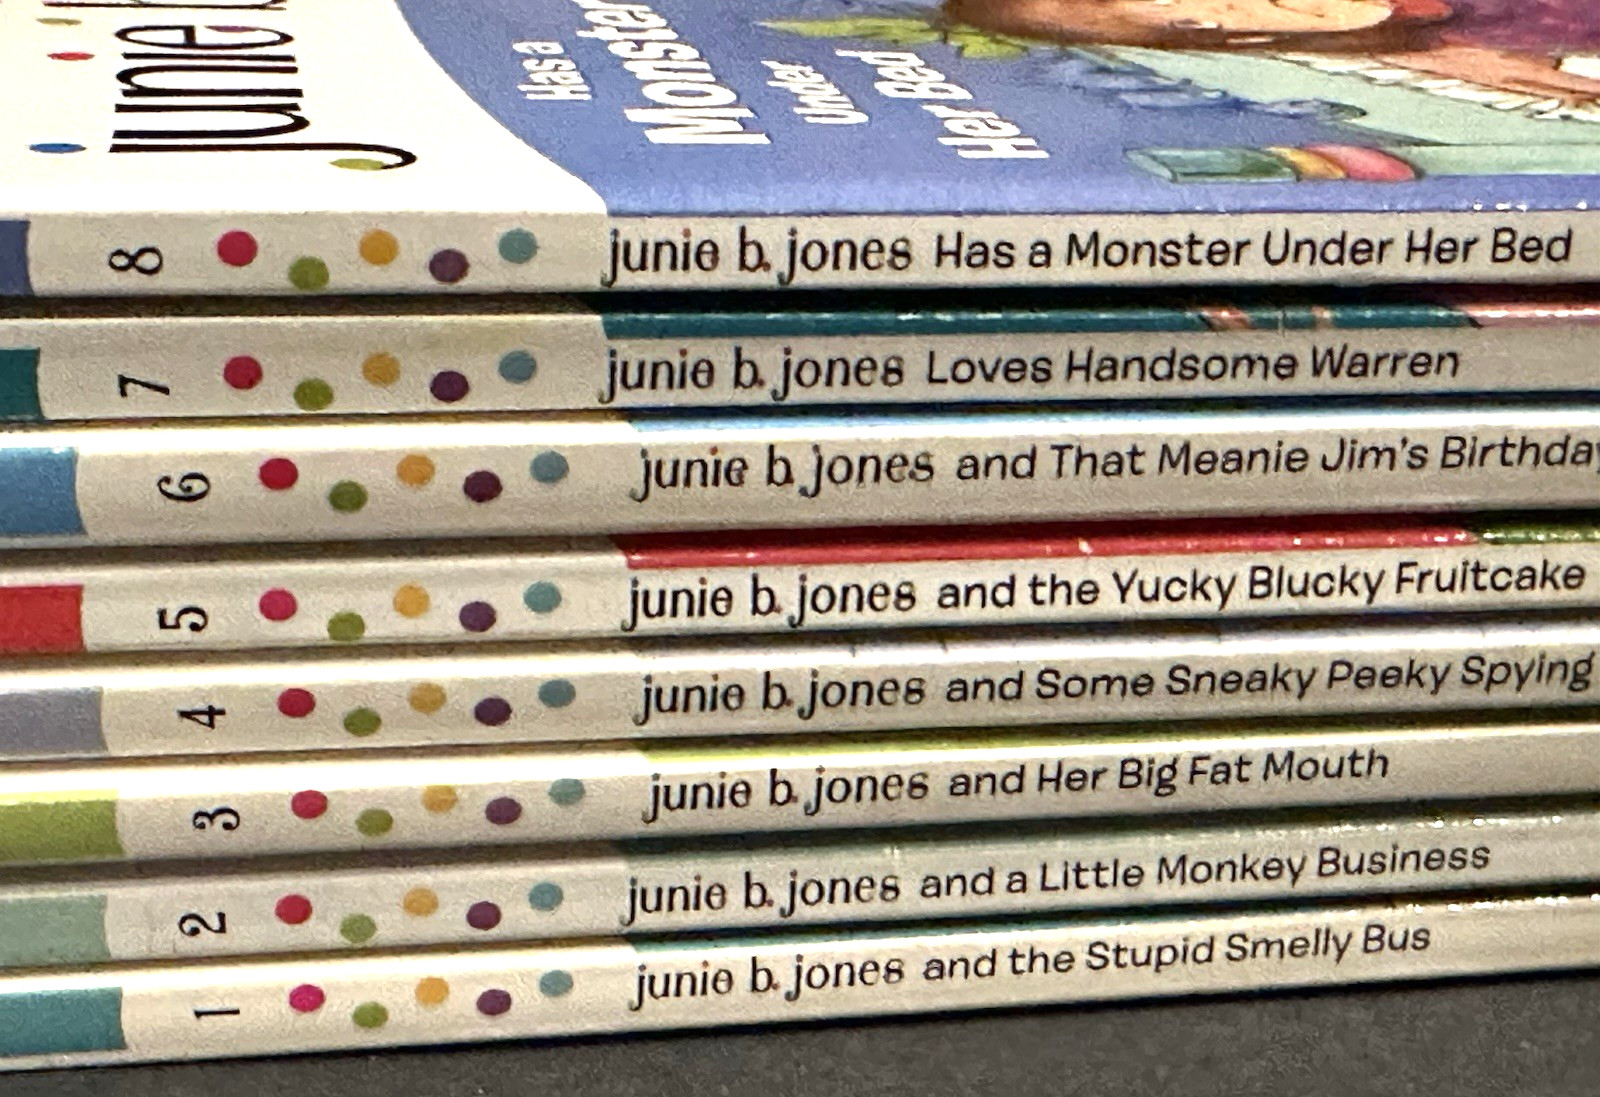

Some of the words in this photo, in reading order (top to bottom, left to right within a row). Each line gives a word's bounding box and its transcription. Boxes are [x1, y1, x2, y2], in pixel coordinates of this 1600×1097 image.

[511, 40, 565, 55] a
[573, 0, 772, 145] Monster
[834, 48, 974, 101] Bed
[28, 25, 417, 170] junie
[517, 57, 593, 101] Has
[760, 59, 870, 125] Under
[920, 103, 1050, 159] Her
[107, 246, 164, 276] 8
[600, 228, 720, 288] junie
[738, 225, 772, 273] b.
[777, 227, 914, 287] jones
[935, 230, 1015, 270] Has
[1028, 240, 1052, 269] a
[1066, 230, 1252, 268] Monster
[1263, 228, 1394, 267] Under
[1405, 227, 1480, 265] Her
[1491, 226, 1573, 264] Bed
[117, 373, 171, 399] 7
[597, 348, 715, 404] junie
[733, 345, 766, 390] b.
[770, 346, 904, 402] jones
[926, 350, 1053, 386] Loves
[1065, 346, 1299, 384] Handsome
[1311, 342, 1460, 380] Warren
[156, 471, 211, 503] 6
[629, 448, 749, 503] junie
[766, 443, 796, 488] b.
[799, 444, 935, 499] jones
[956, 444, 1038, 481] and
[1050, 443, 1147, 479] That
[1158, 439, 1310, 477] Meanie
[1320, 436, 1429, 473] Jim's
[1440, 433, 1600, 475] Birthda
[157, 605, 209, 633] 5
[620, 577, 733, 632] junie
[751, 572, 783, 617] b.
[788, 573, 917, 628] jones
[937, 574, 1017, 609] and
[1028, 573, 1100, 607] the
[1112, 567, 1237, 612] Yucky
[1248, 565, 1386, 605] Blucky
[1395, 558, 1587, 595] Fruitcake
[633, 674, 746, 726] junie
[762, 670, 794, 711] b.
[797, 669, 926, 720] jones
[945, 670, 1025, 703] and
[1035, 667, 1155, 701] Some
[1165, 662, 1318, 701] Sneaky
[1326, 658, 1452, 697] Peeky
[1460, 650, 1597, 695] Spying
[176, 704, 227, 731] 4
[641, 771, 752, 824] junie
[769, 767, 800, 808] b.
[803, 764, 930, 817] jones
[949, 764, 1026, 797] and
[1037, 760, 1109, 794] Her
[1118, 756, 1178, 798] Big
[1188, 754, 1253, 787] Fat
[1262, 748, 1390, 784] Mouth
[192, 806, 241, 832] 3
[620, 875, 727, 926] junie
[744, 870, 775, 909] b.
[779, 869, 901, 918] jones
[920, 866, 995, 899] and
[1006, 870, 1028, 895] a
[1040, 858, 1146, 892] Little
[1157, 852, 1308, 888] Monkey
[1317, 845, 1491, 879] Business
[178, 911, 227, 937] 2
[629, 960, 735, 1011] junie
[750, 956, 780, 993] b.
[784, 953, 905, 1001] jones
[922, 948, 998, 982] and
[1008, 946, 1077, 977] the
[1086, 936, 1215, 974] Stupid
[1225, 926, 1354, 965] Smelly
[1363, 923, 1431, 954] Bus
[193, 1008, 241, 1020] 1
